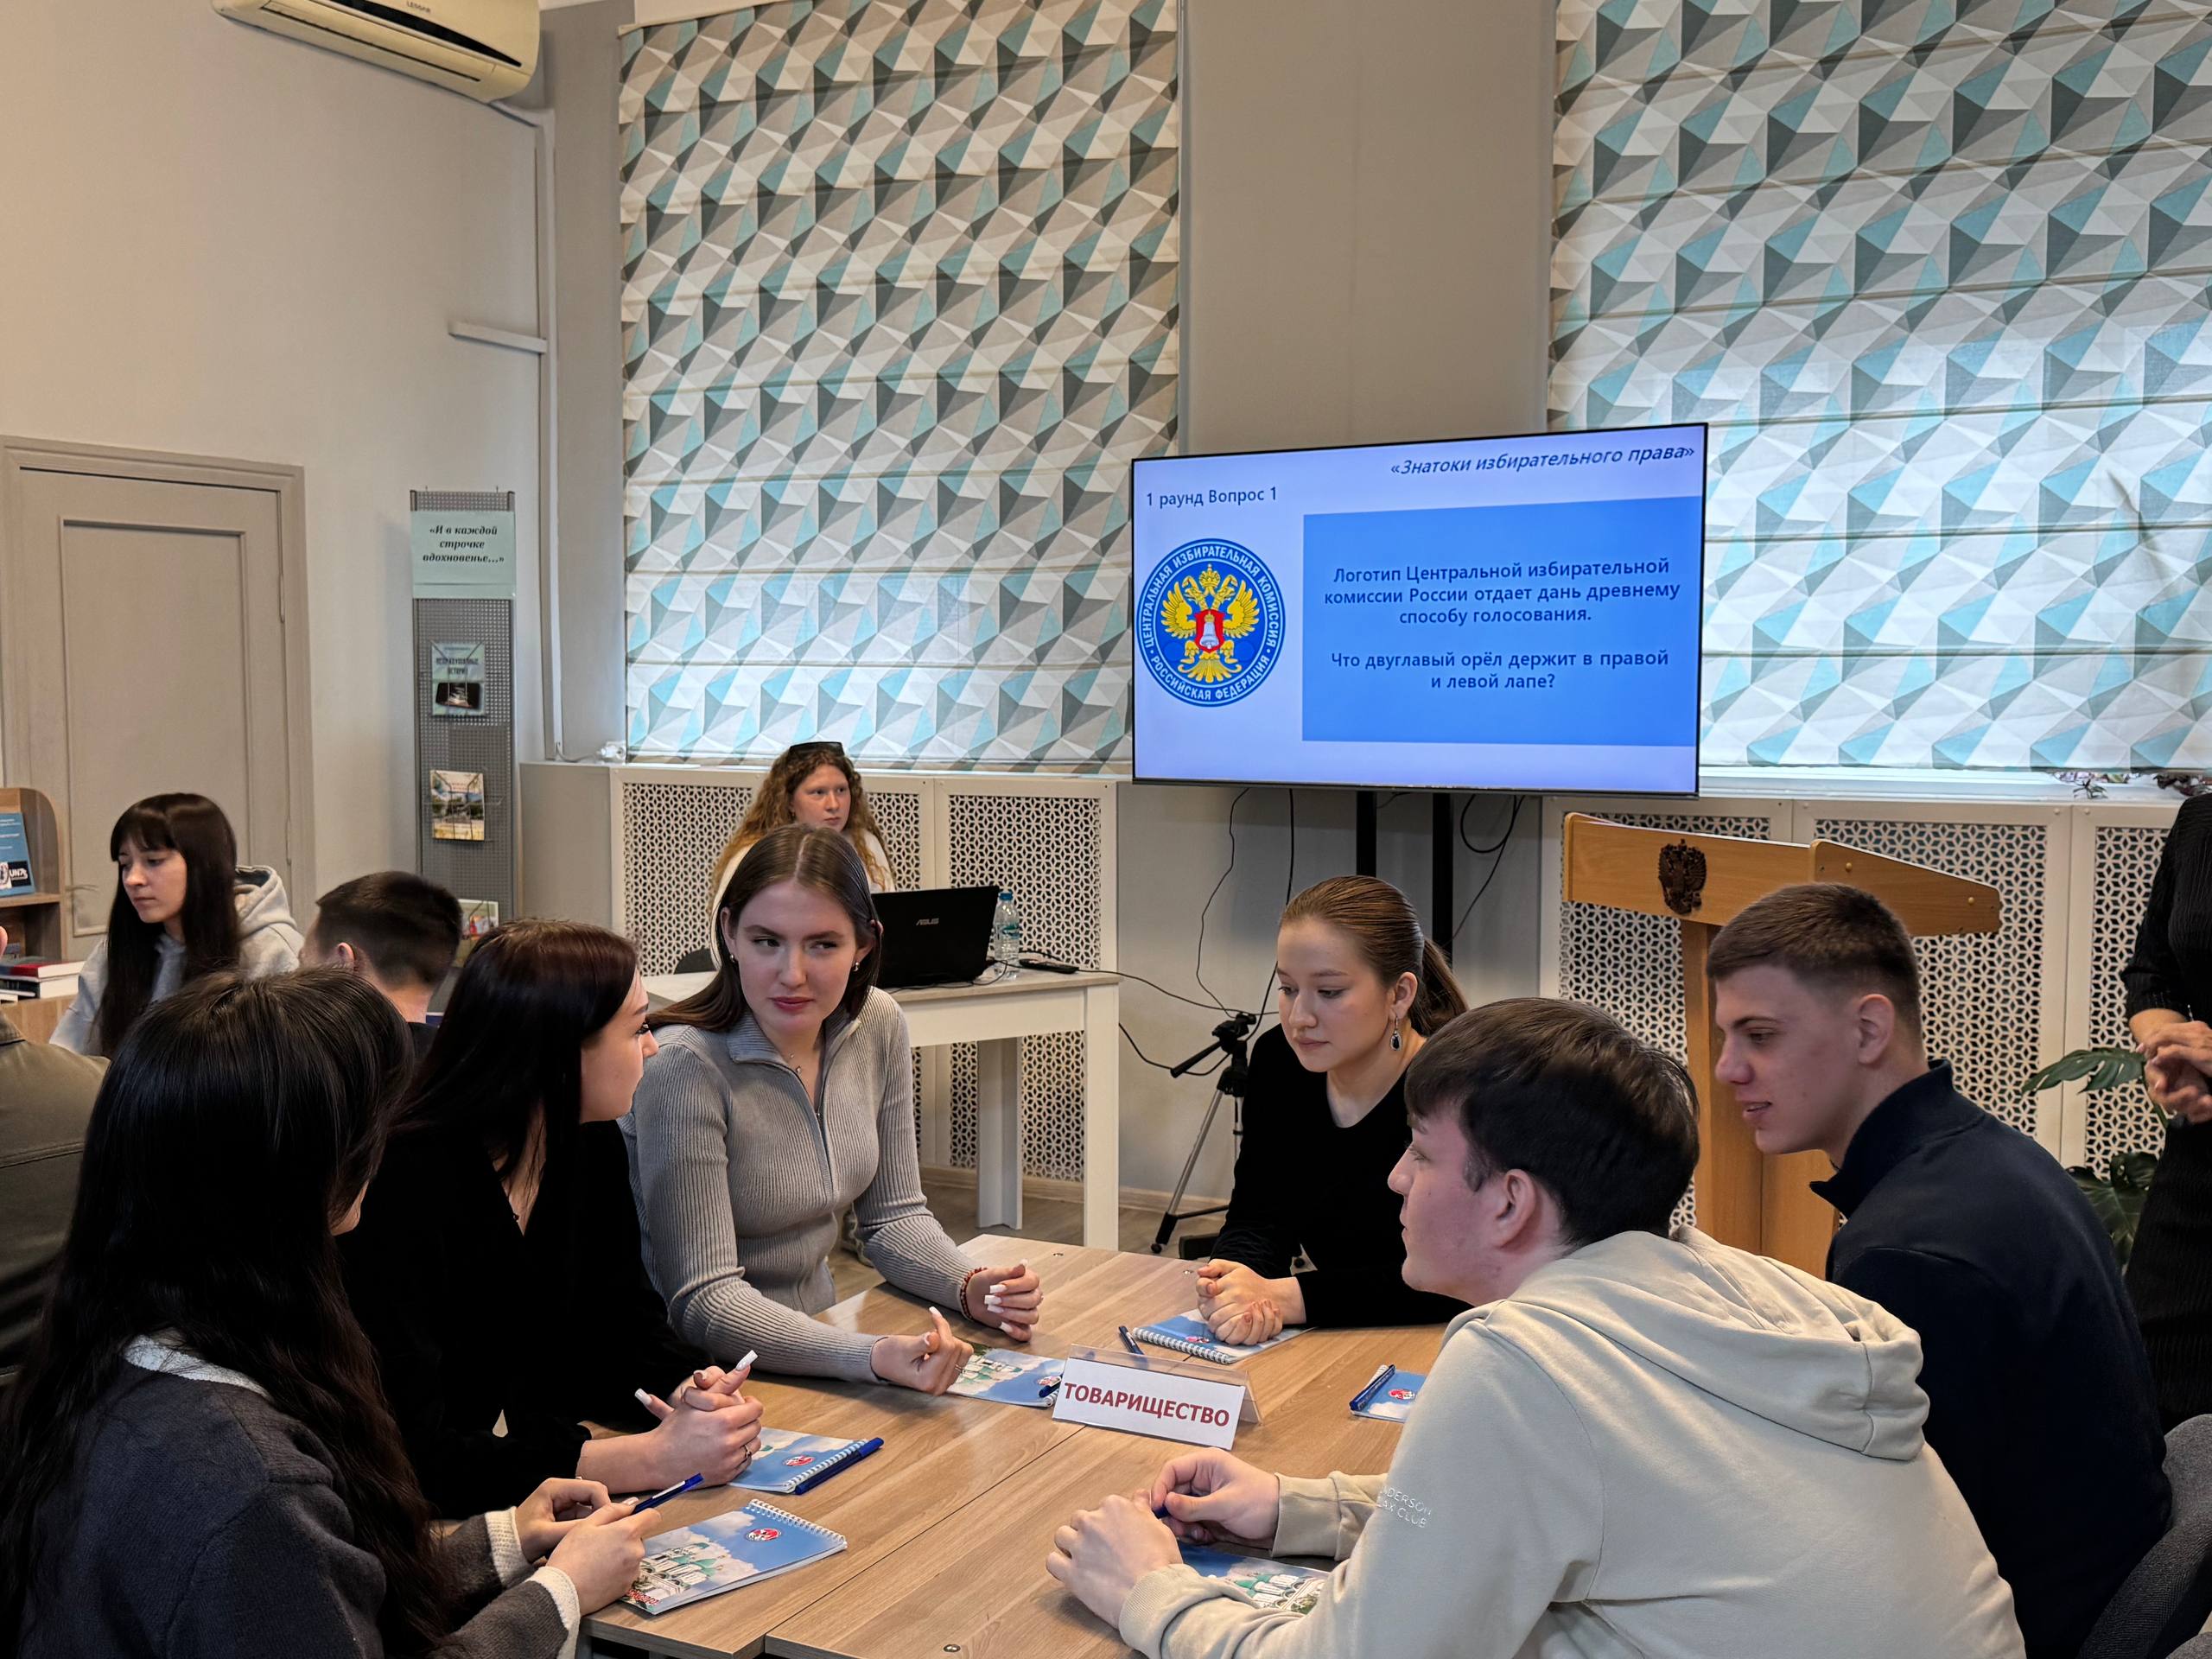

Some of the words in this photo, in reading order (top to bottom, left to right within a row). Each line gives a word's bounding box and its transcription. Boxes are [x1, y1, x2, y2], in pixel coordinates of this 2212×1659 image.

[1391, 459, 1471, 475] «Знатоки
[1475, 450, 1624, 473] избирательного
[1628, 446, 1694, 467] права»
[1147, 493, 1153, 506] 1
[1160, 493, 1204, 509] раунд
[1209, 489, 1264, 505] Вопрос
[1270, 486, 1276, 500] 1
[454, 525, 498, 535] каждой
[440, 540, 485, 550] строчке
[1333, 568, 1402, 582] Логотип
[1407, 563, 1522, 583] Центральной
[1528, 557, 1669, 580] избирательной
[1142, 566, 1173, 649] ЦЕНТРАЛЬНАЯ
[1173, 545, 1261, 577] ИЗБИРАТЕЛЬНАЯ
[1257, 575, 1280, 649] КОМИССИЯ
[1325, 591, 1402, 604] комиссии
[1409, 588, 1468, 602] России
[1474, 588, 1532, 604] отдает
[1537, 587, 1581, 602] дань
[1586, 584, 1681, 601] древнему
[1399, 608, 1467, 626] способу
[1473, 609, 1592, 623] голосования.
[1332, 652, 1360, 667] Что
[1365, 652, 1455, 671] двуглавый
[1461, 652, 1503, 671] орёл
[1508, 654, 1576, 670] держит
[1583, 654, 1592, 665] в
[1600, 649, 1669, 670] правой
[1150, 655, 1211, 701] РОССИЙСКАЯ
[1215, 655, 1270, 701] ФЕДЕРАЦИЯ
[1431, 677, 1440, 689] и
[1446, 673, 1499, 689] левой
[1504, 673, 1555, 689] лапе?
[1065, 1382, 1230, 1427] ТОВАРИЩЕСТВО
[1397, 1507, 1427, 1528] CLUB
